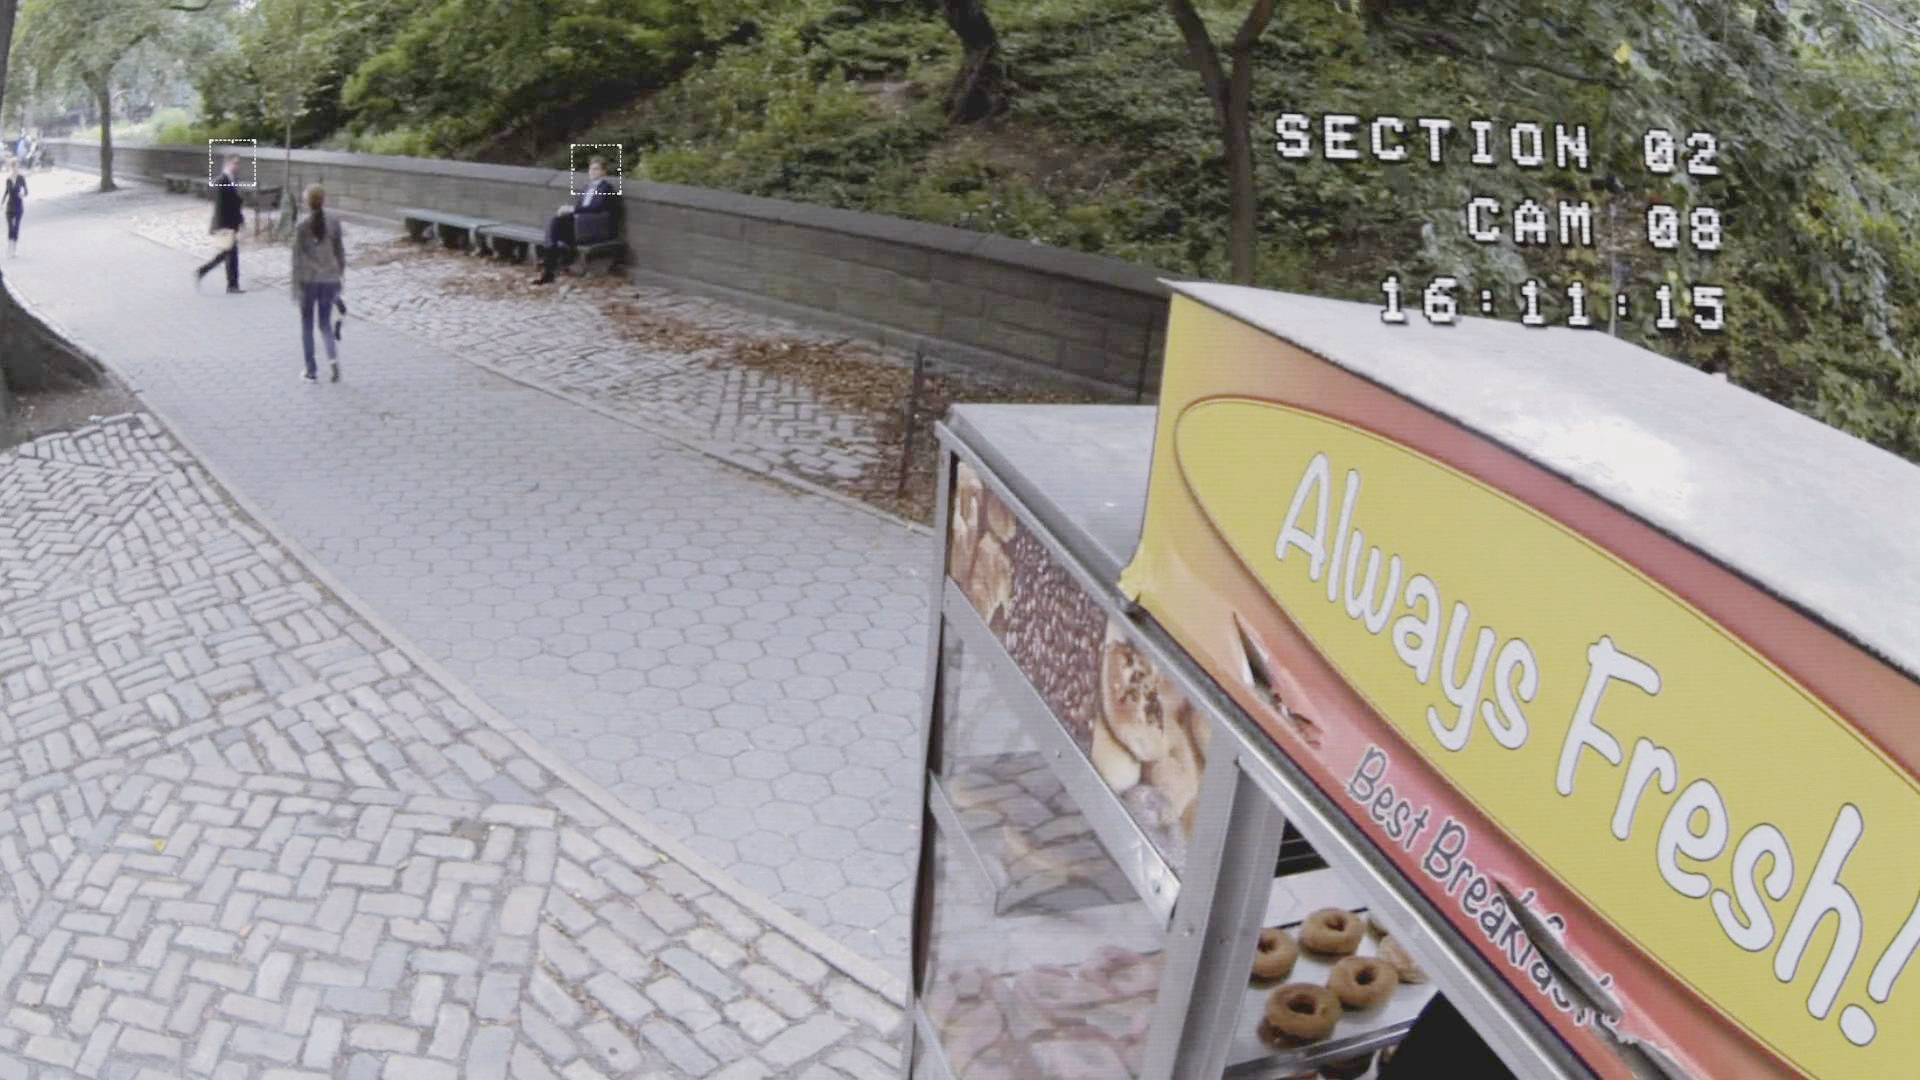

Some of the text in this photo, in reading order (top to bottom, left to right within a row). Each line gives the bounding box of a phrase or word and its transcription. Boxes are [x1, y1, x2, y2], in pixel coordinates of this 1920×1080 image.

[1275, 451, 1920, 1047] Always Fresh!
[1348, 745, 1430, 851] Best
